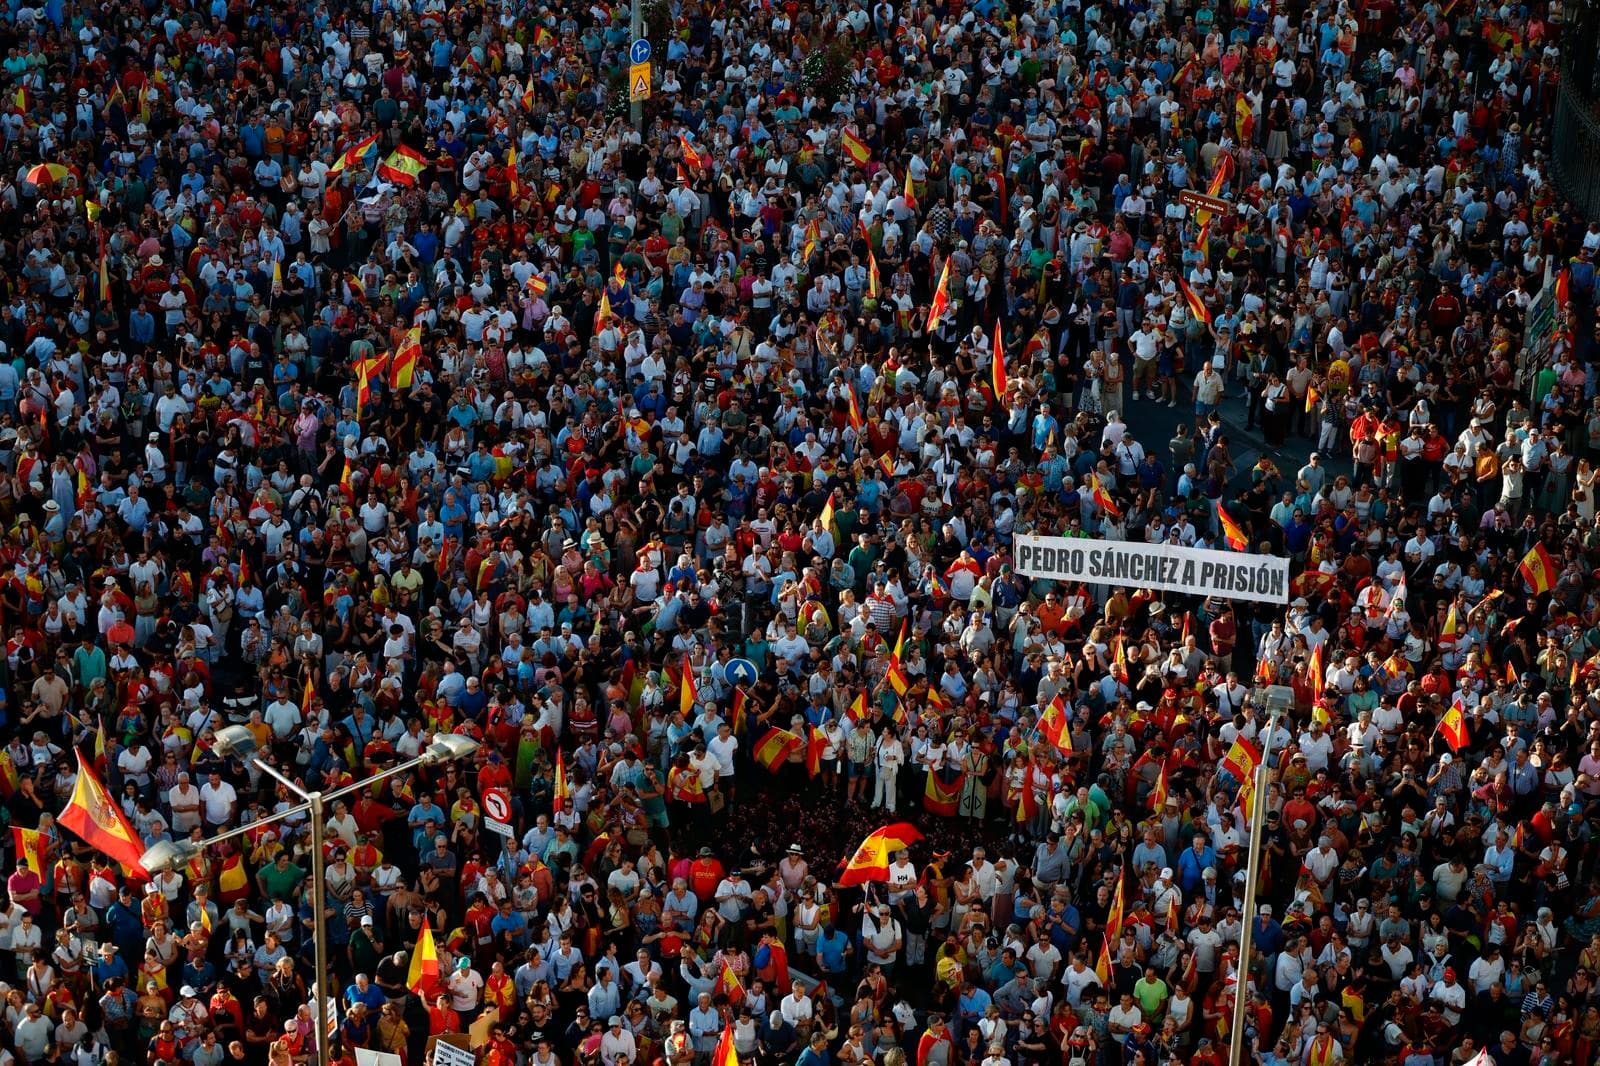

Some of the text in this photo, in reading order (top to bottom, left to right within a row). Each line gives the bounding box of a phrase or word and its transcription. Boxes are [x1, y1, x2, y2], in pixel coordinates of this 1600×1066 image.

[1020, 545, 1283, 596] PEDRO SÁNCHEZ A PRISIÓN
